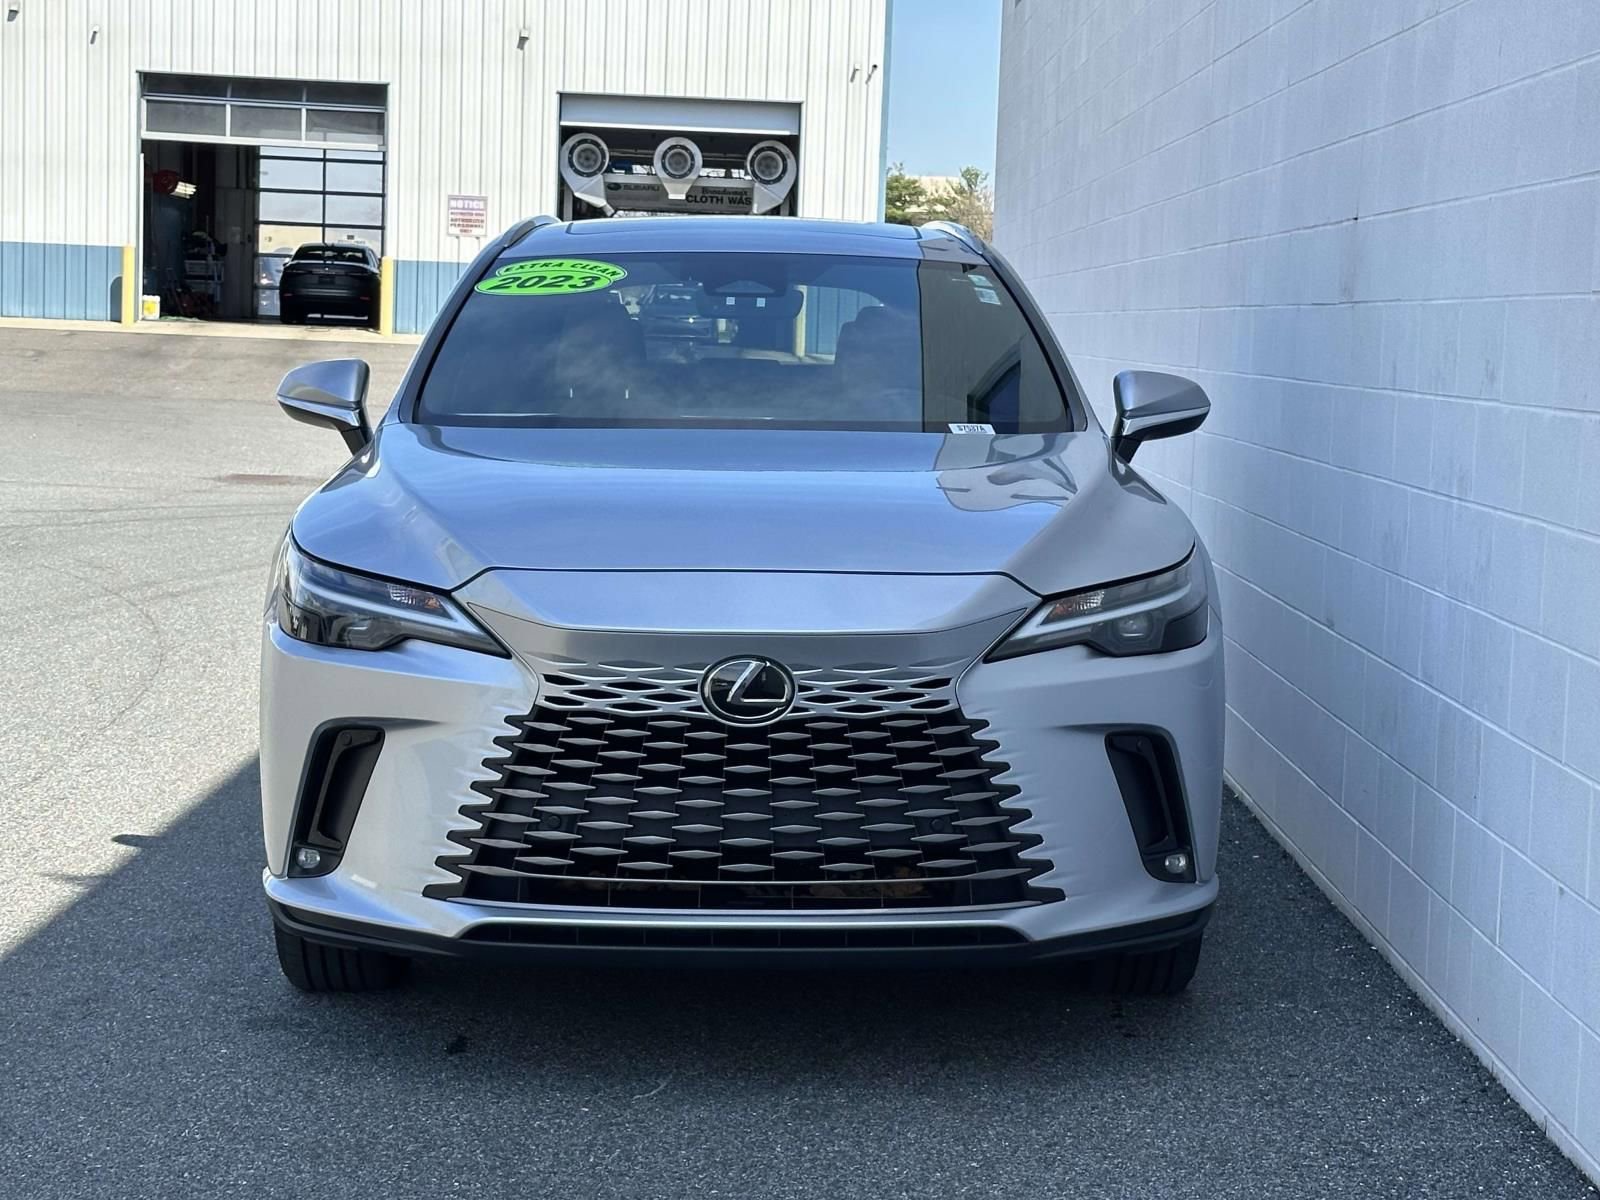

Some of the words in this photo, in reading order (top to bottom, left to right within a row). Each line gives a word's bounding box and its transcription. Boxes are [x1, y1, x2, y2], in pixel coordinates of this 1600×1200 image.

[623, 184, 660, 192] SUBARU
[449, 199, 485, 209] NOTICE
[686, 194, 724, 205] CLOTH
[504, 261, 564, 272] EXTRA
[570, 262, 621, 278] CLEAN
[486, 274, 601, 290] 2023
